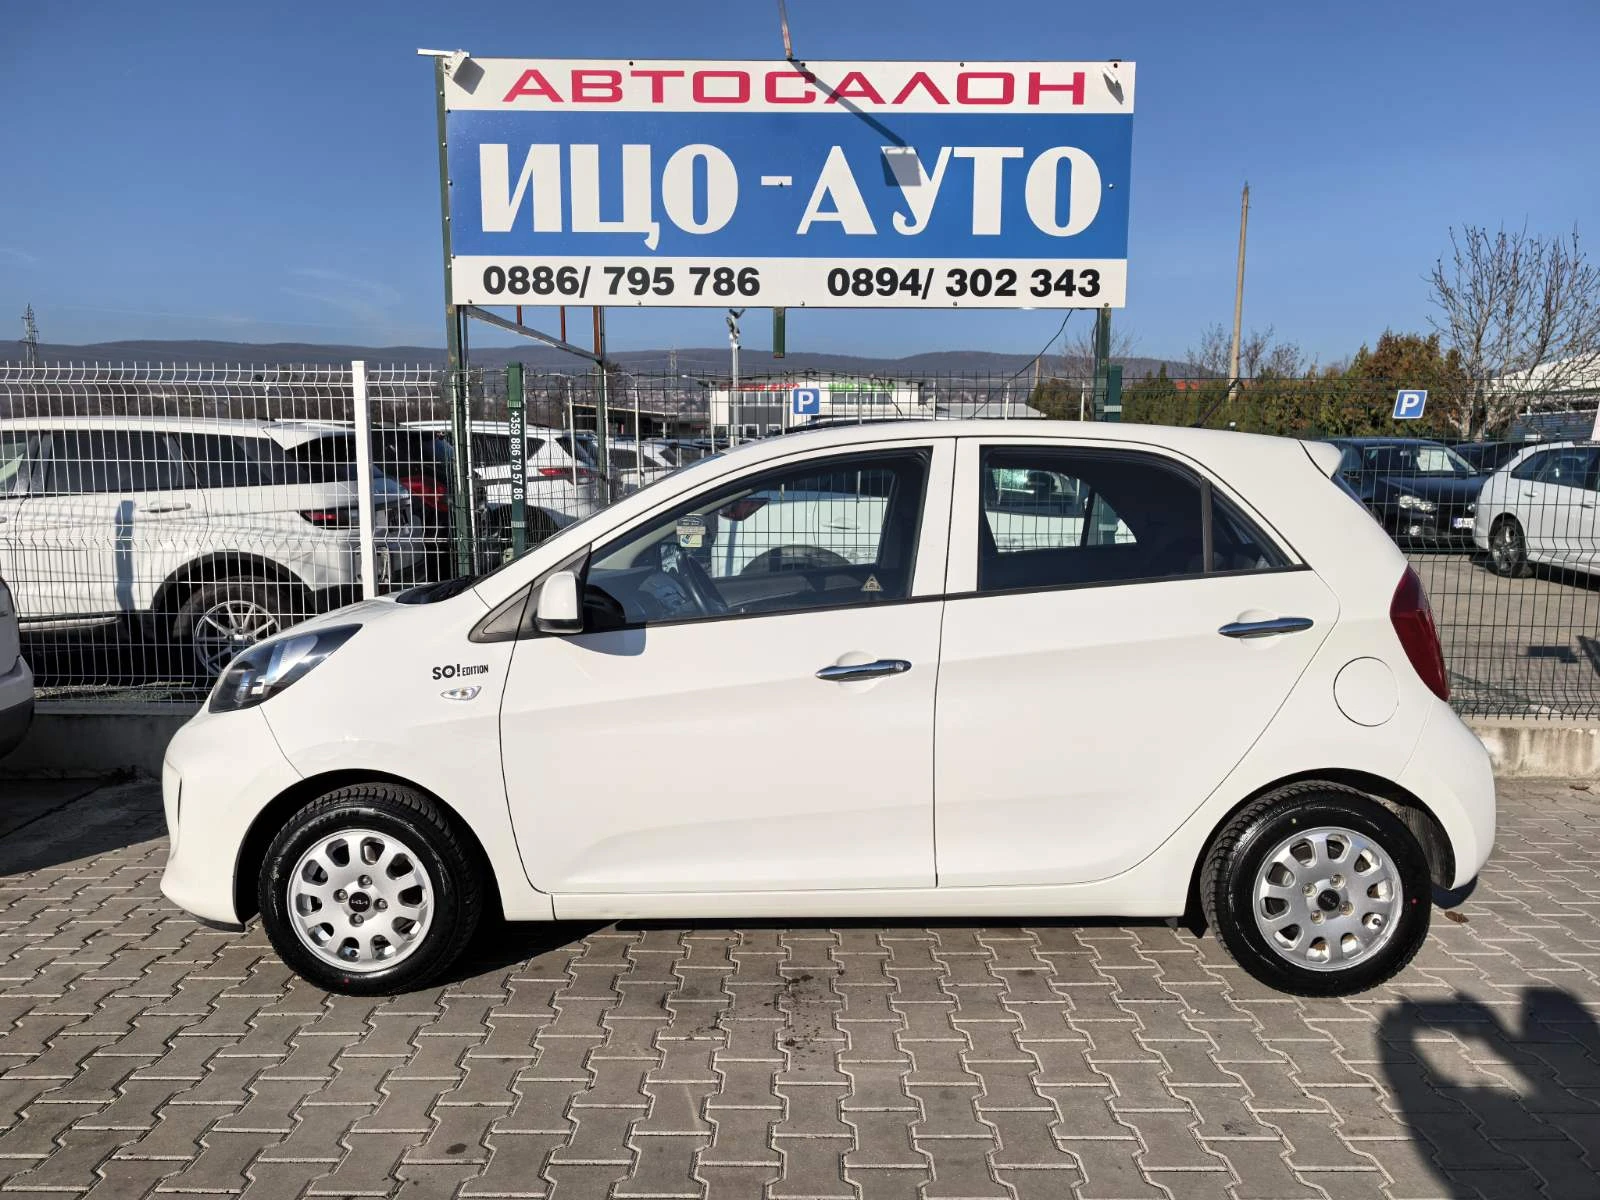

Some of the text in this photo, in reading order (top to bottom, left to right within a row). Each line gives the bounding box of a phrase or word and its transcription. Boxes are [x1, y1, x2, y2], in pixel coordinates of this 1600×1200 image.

[502, 69, 1086, 105] АВТОСАЛОН
[482, 265, 761, 299] 0886/ 795 786
[827, 267, 1101, 300] 0894/ 302 343
[798, 391, 815, 413] P
[1400, 393, 1420, 415] P
[510, 410, 524, 500] +359 886 79 57 86
[432, 663, 489, 680] SO! EDITION
